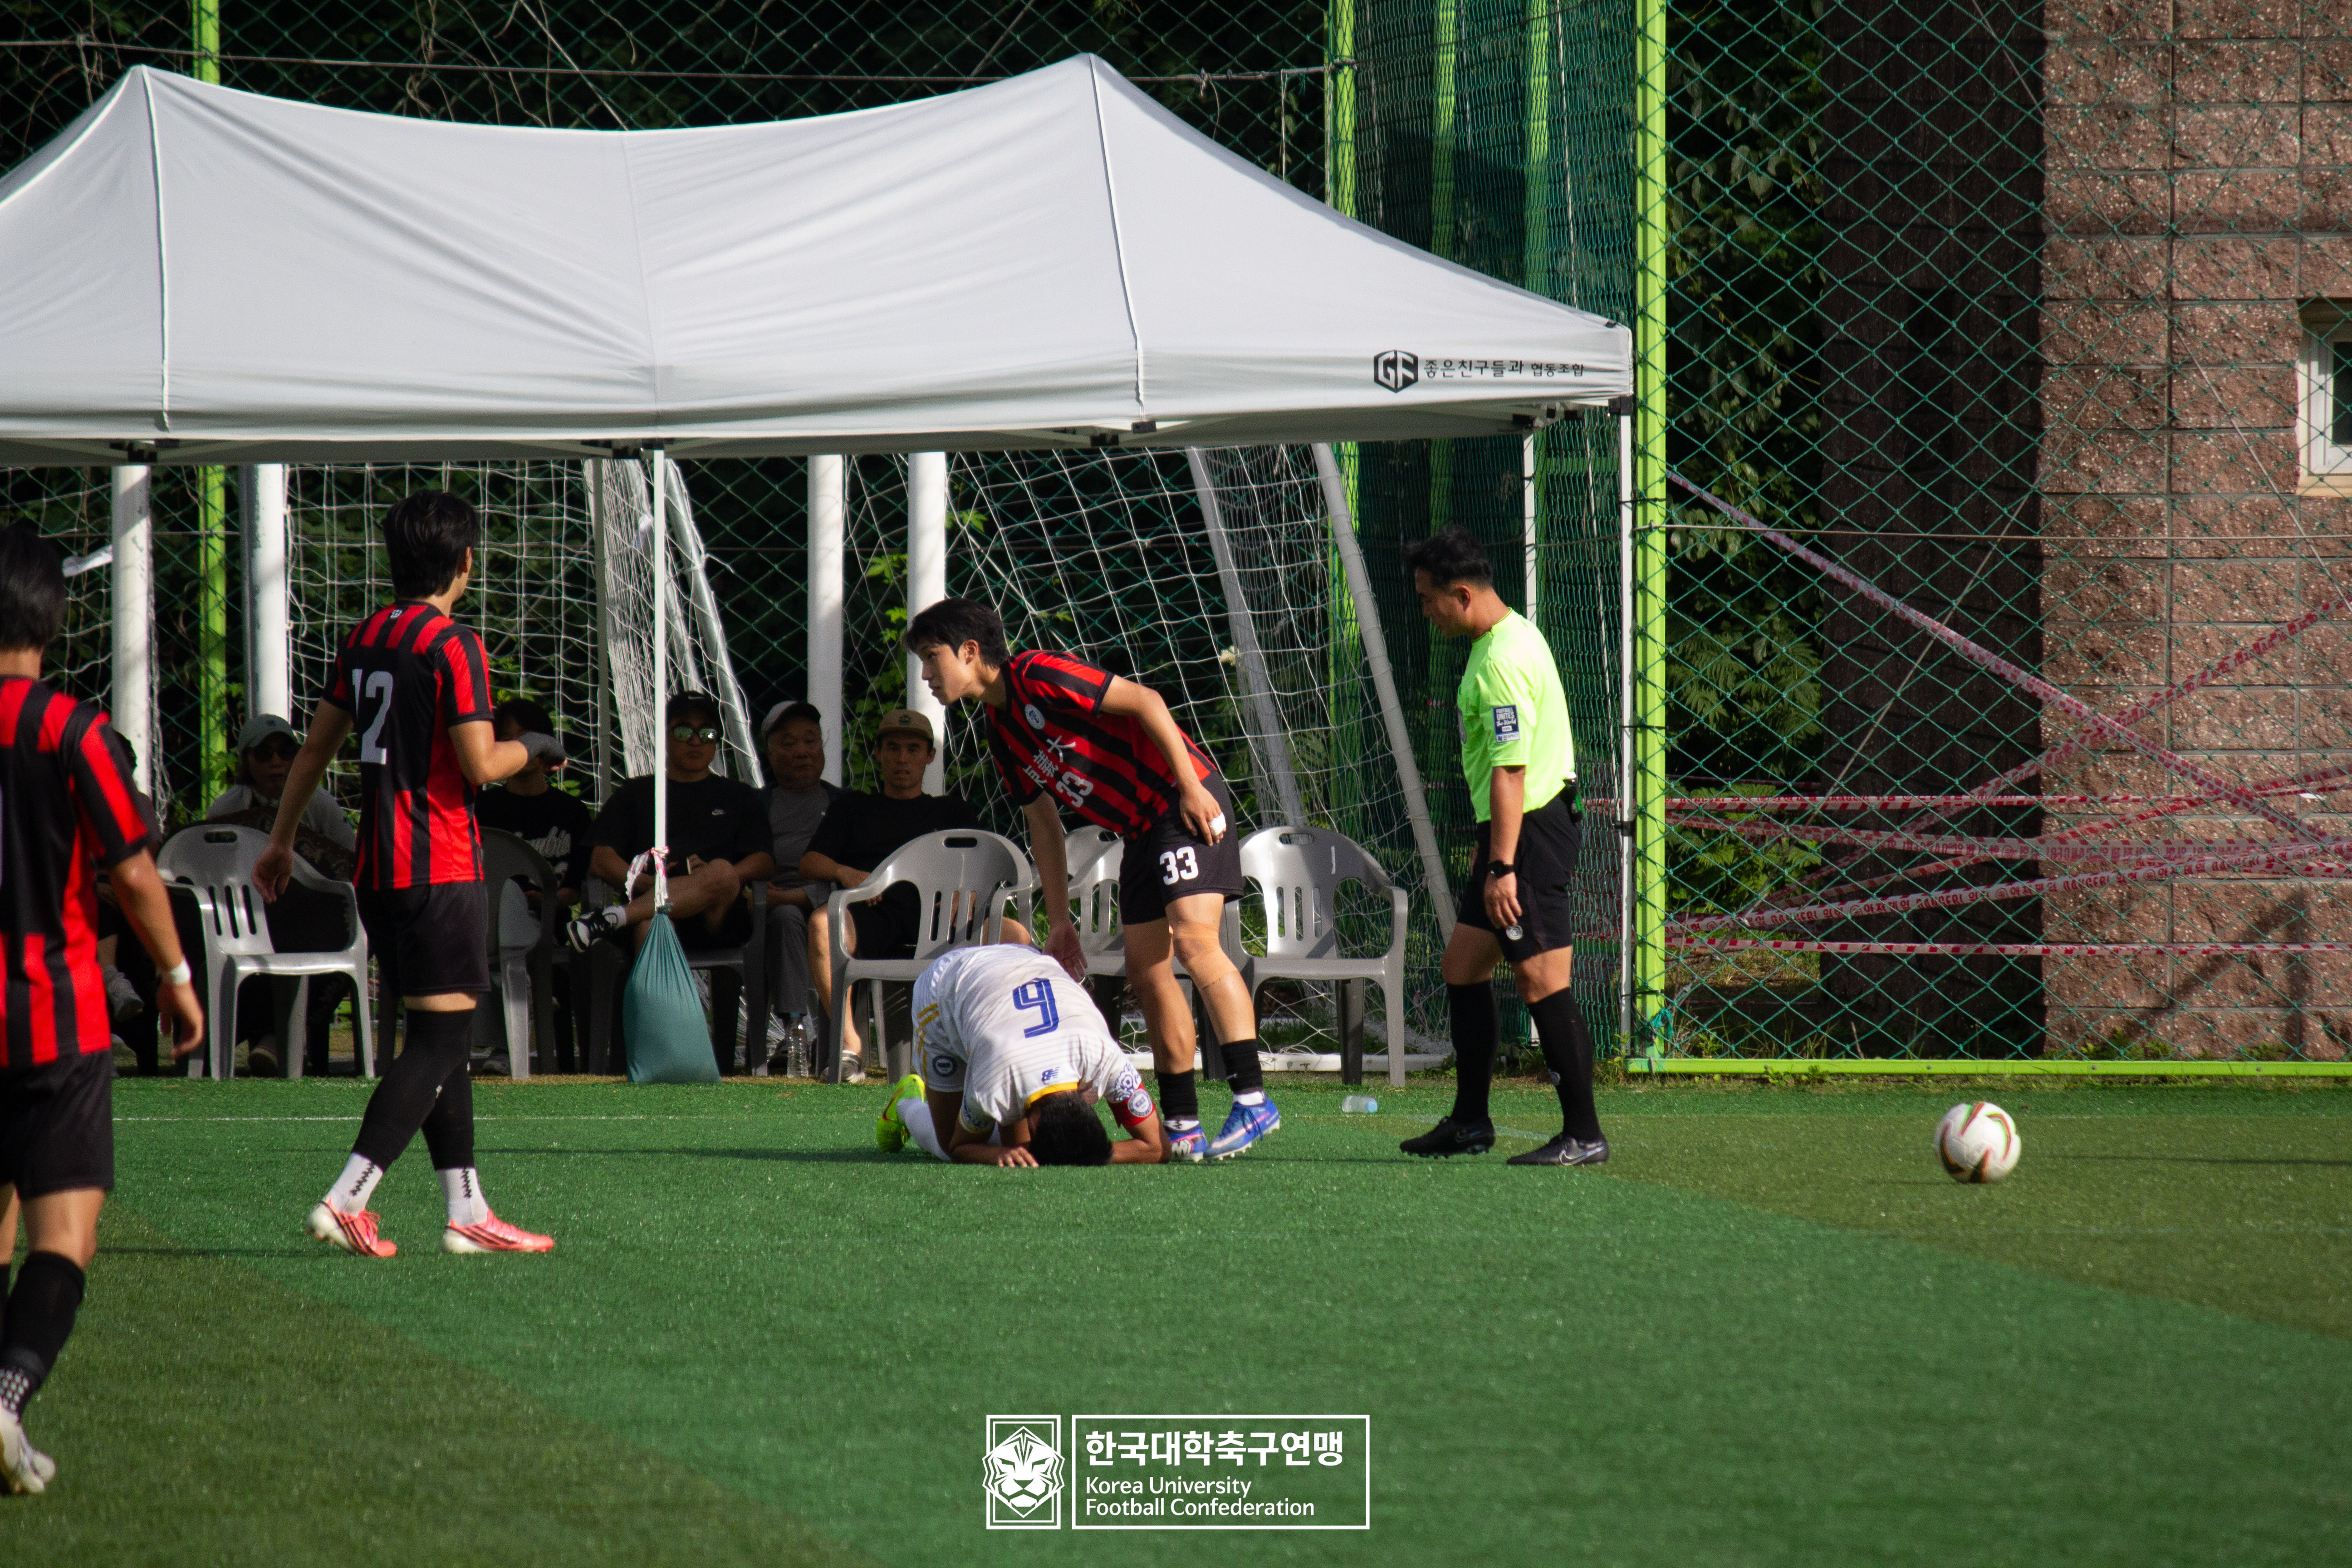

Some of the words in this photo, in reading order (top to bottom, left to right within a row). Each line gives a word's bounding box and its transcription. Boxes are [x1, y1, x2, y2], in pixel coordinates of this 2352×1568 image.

[1423, 359, 1524, 377] 좋은친구들과
[1531, 363, 1585, 377] 협동조합
[352, 669, 393, 764] 12
[1056, 771, 1094, 807] 33
[1160, 847, 1199, 885] 33
